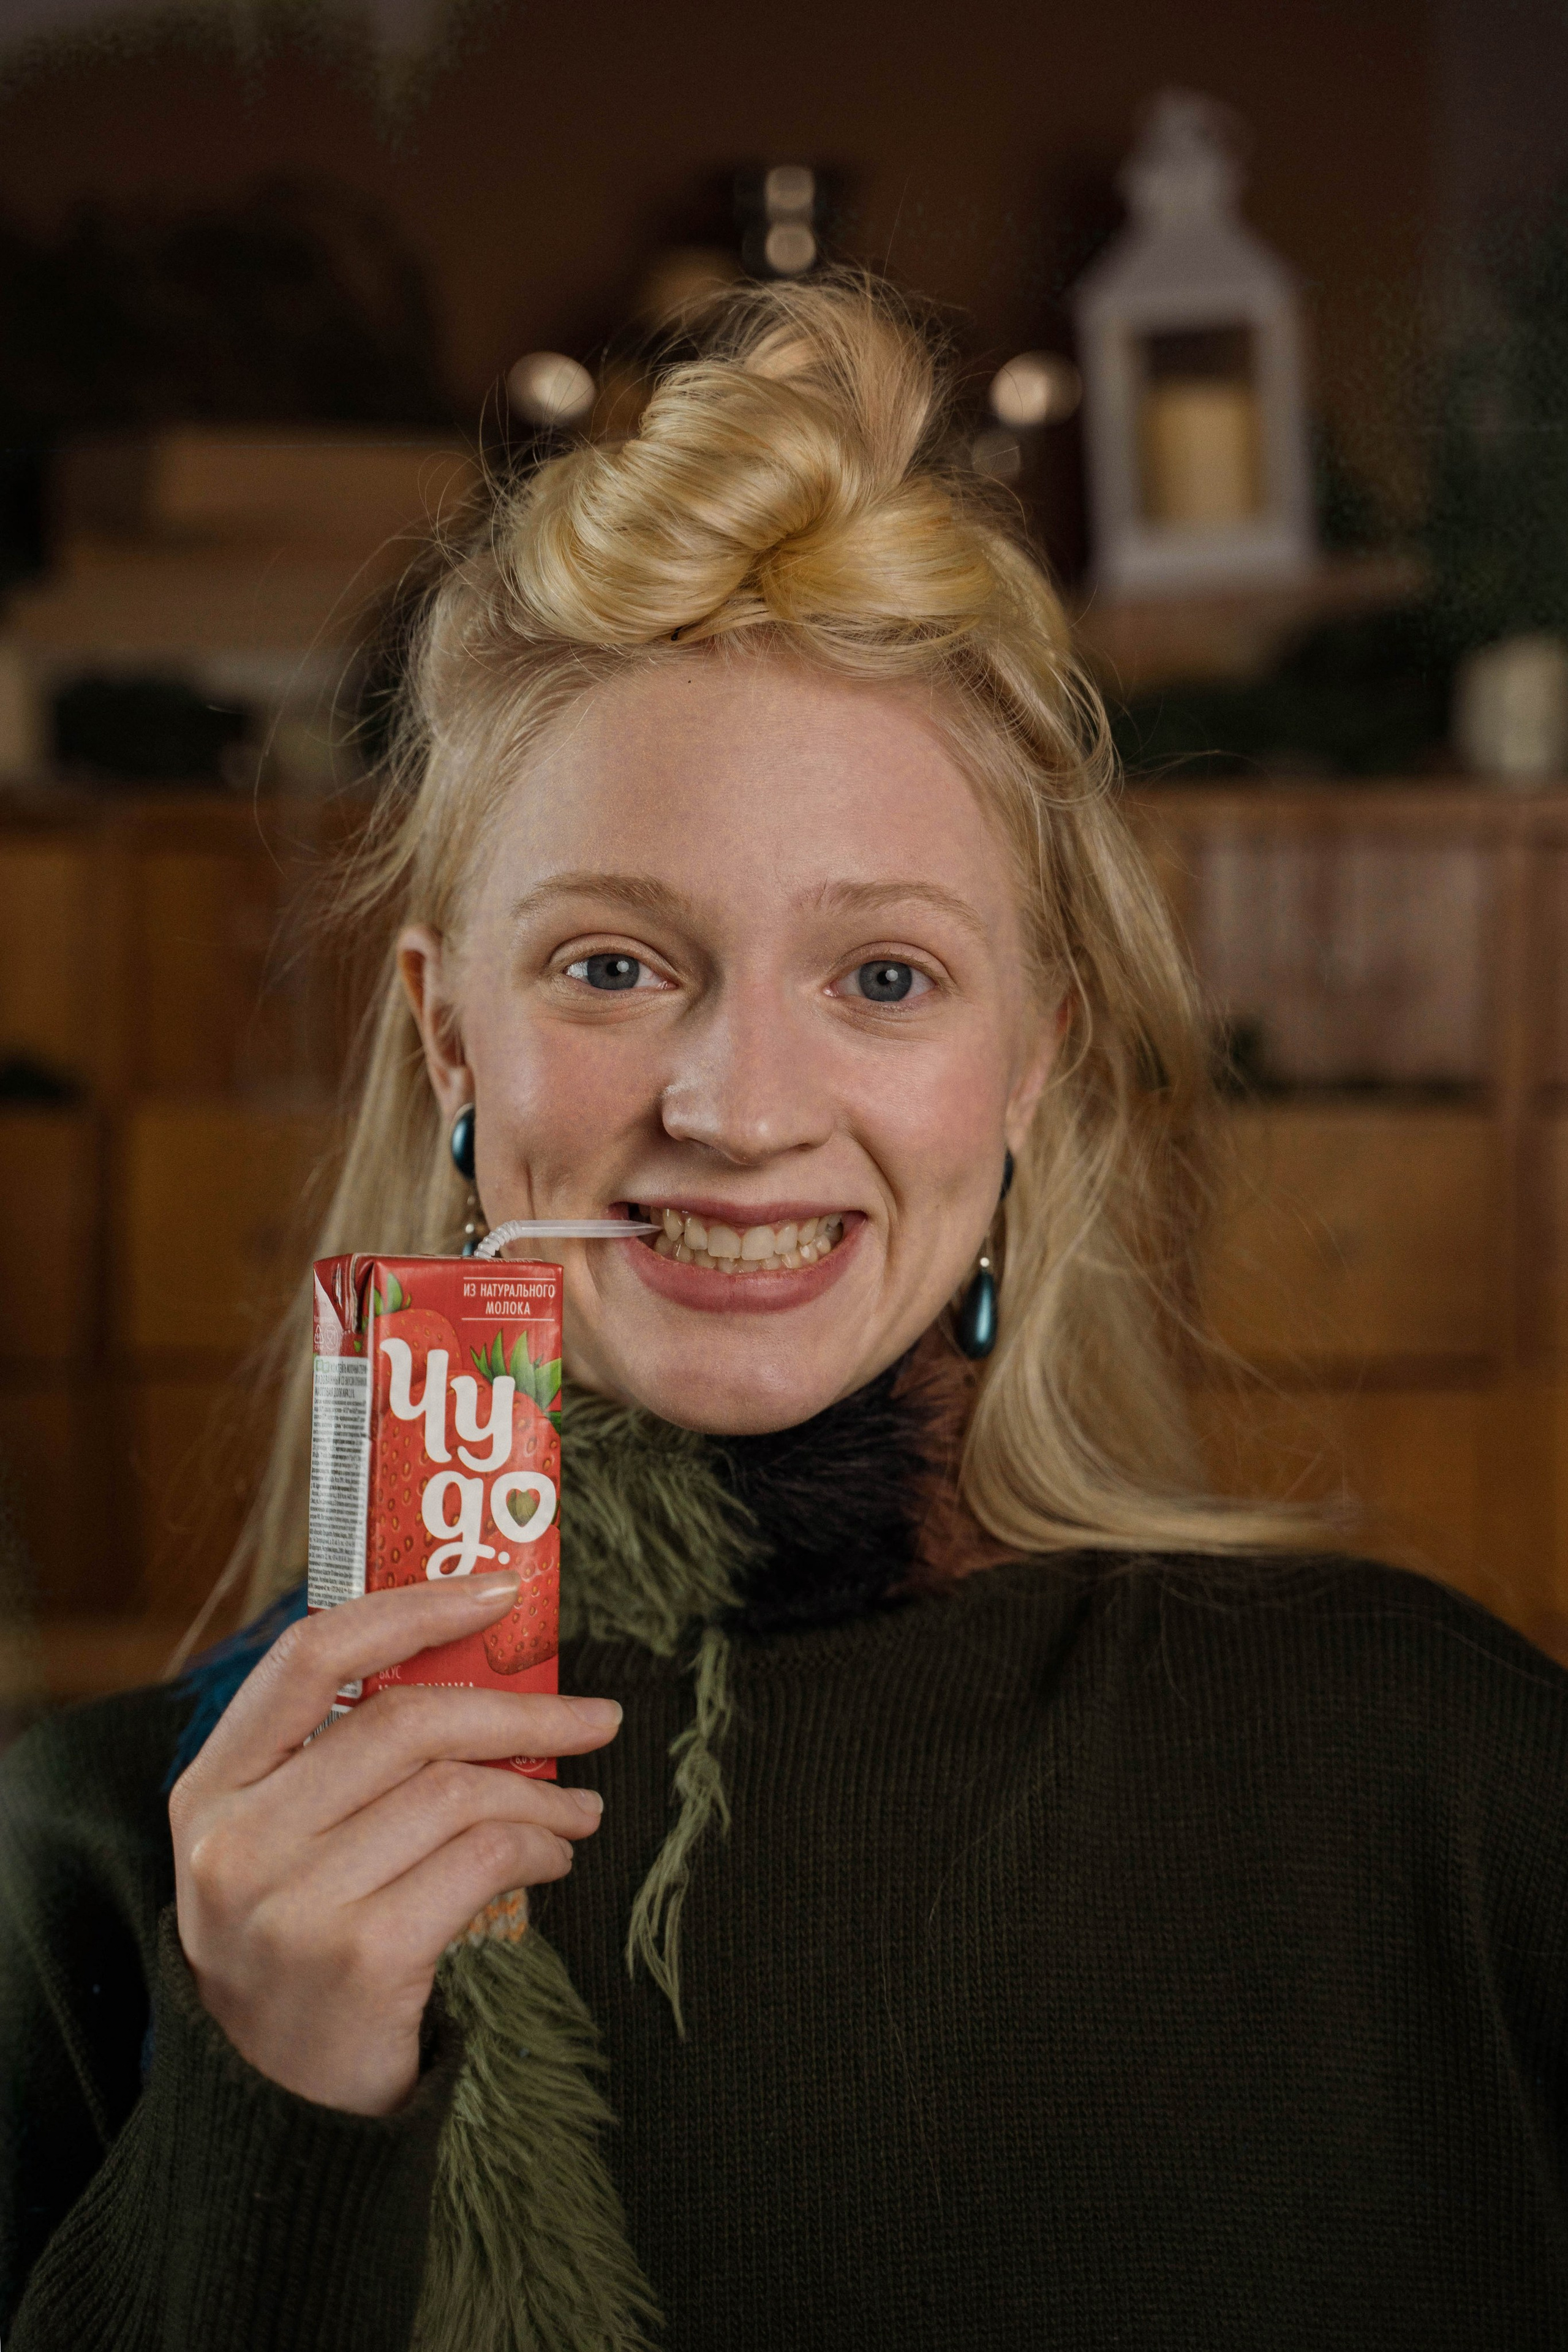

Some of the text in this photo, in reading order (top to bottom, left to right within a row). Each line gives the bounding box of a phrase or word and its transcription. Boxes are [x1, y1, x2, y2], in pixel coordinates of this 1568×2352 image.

[463, 1283, 556, 1299] ИЗ НАТУРАЛЬНОГО
[485, 1301, 530, 1315] МОЛОКА
